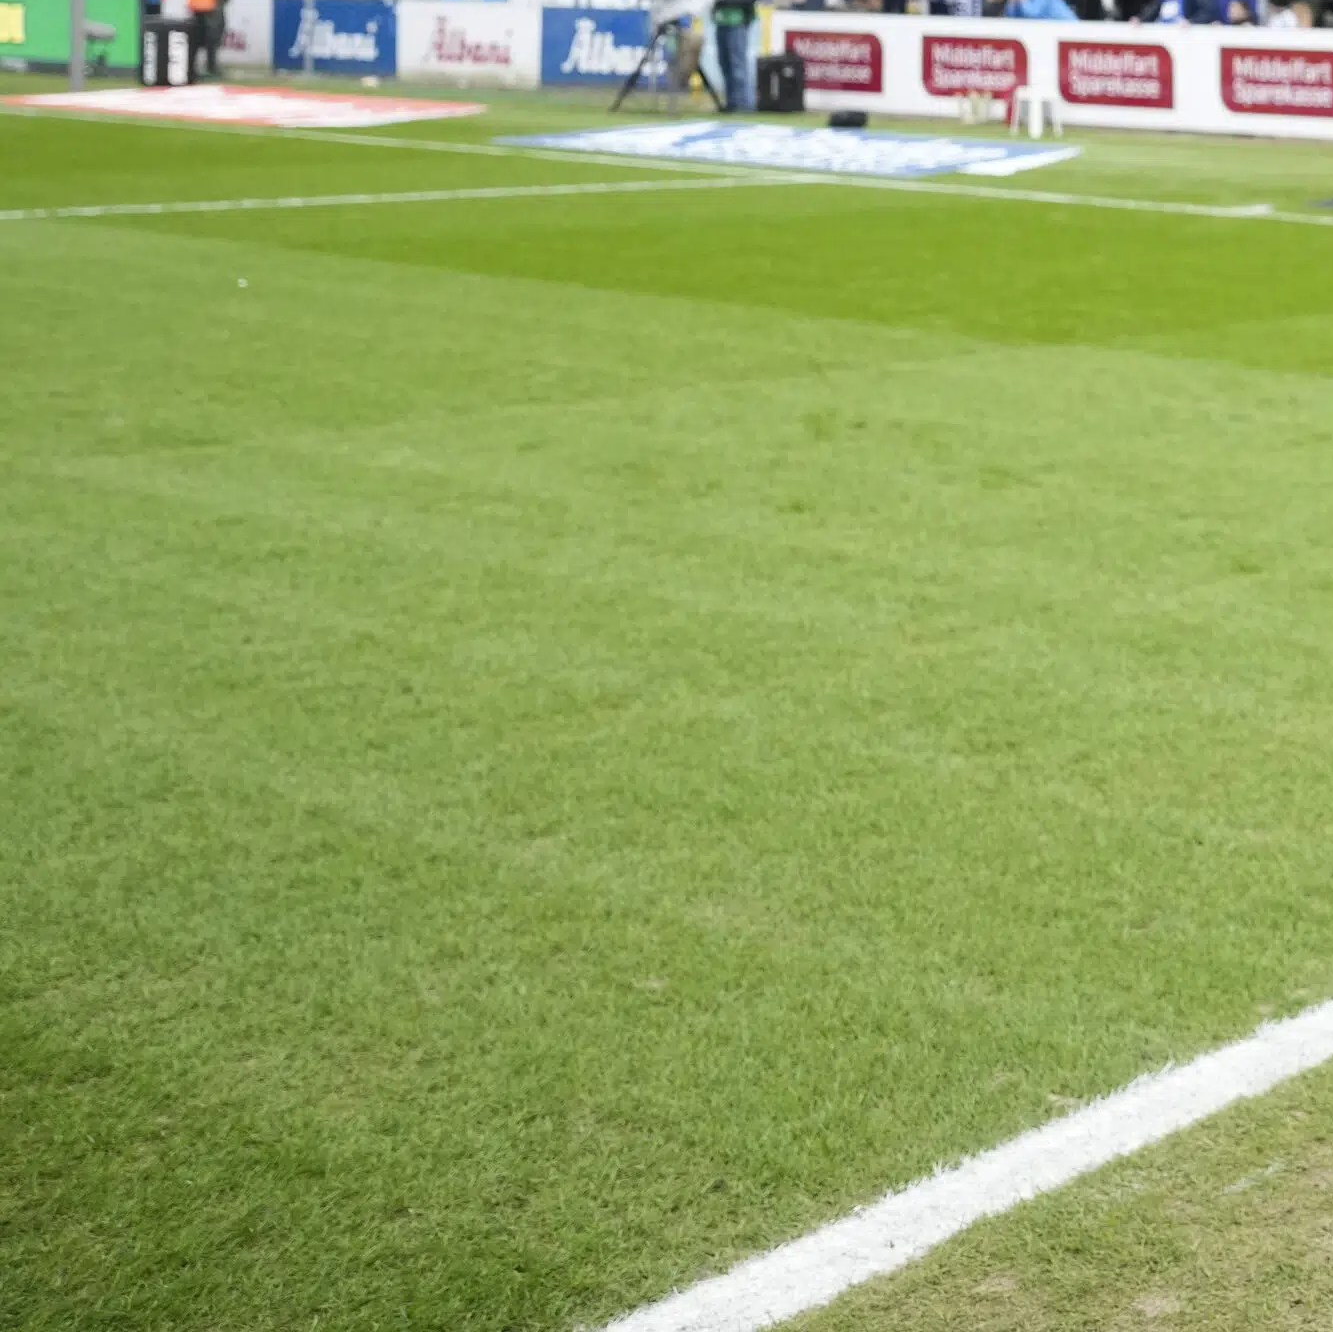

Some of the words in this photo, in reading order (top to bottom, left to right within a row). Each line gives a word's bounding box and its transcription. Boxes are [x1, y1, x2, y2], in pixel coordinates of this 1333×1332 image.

[931, 42, 1015, 69] Middelfart
[1067, 48, 1159, 77] Middelfart
[1232, 54, 1333, 85] Middelfart
[1068, 71, 1161, 99] Sparekasse
